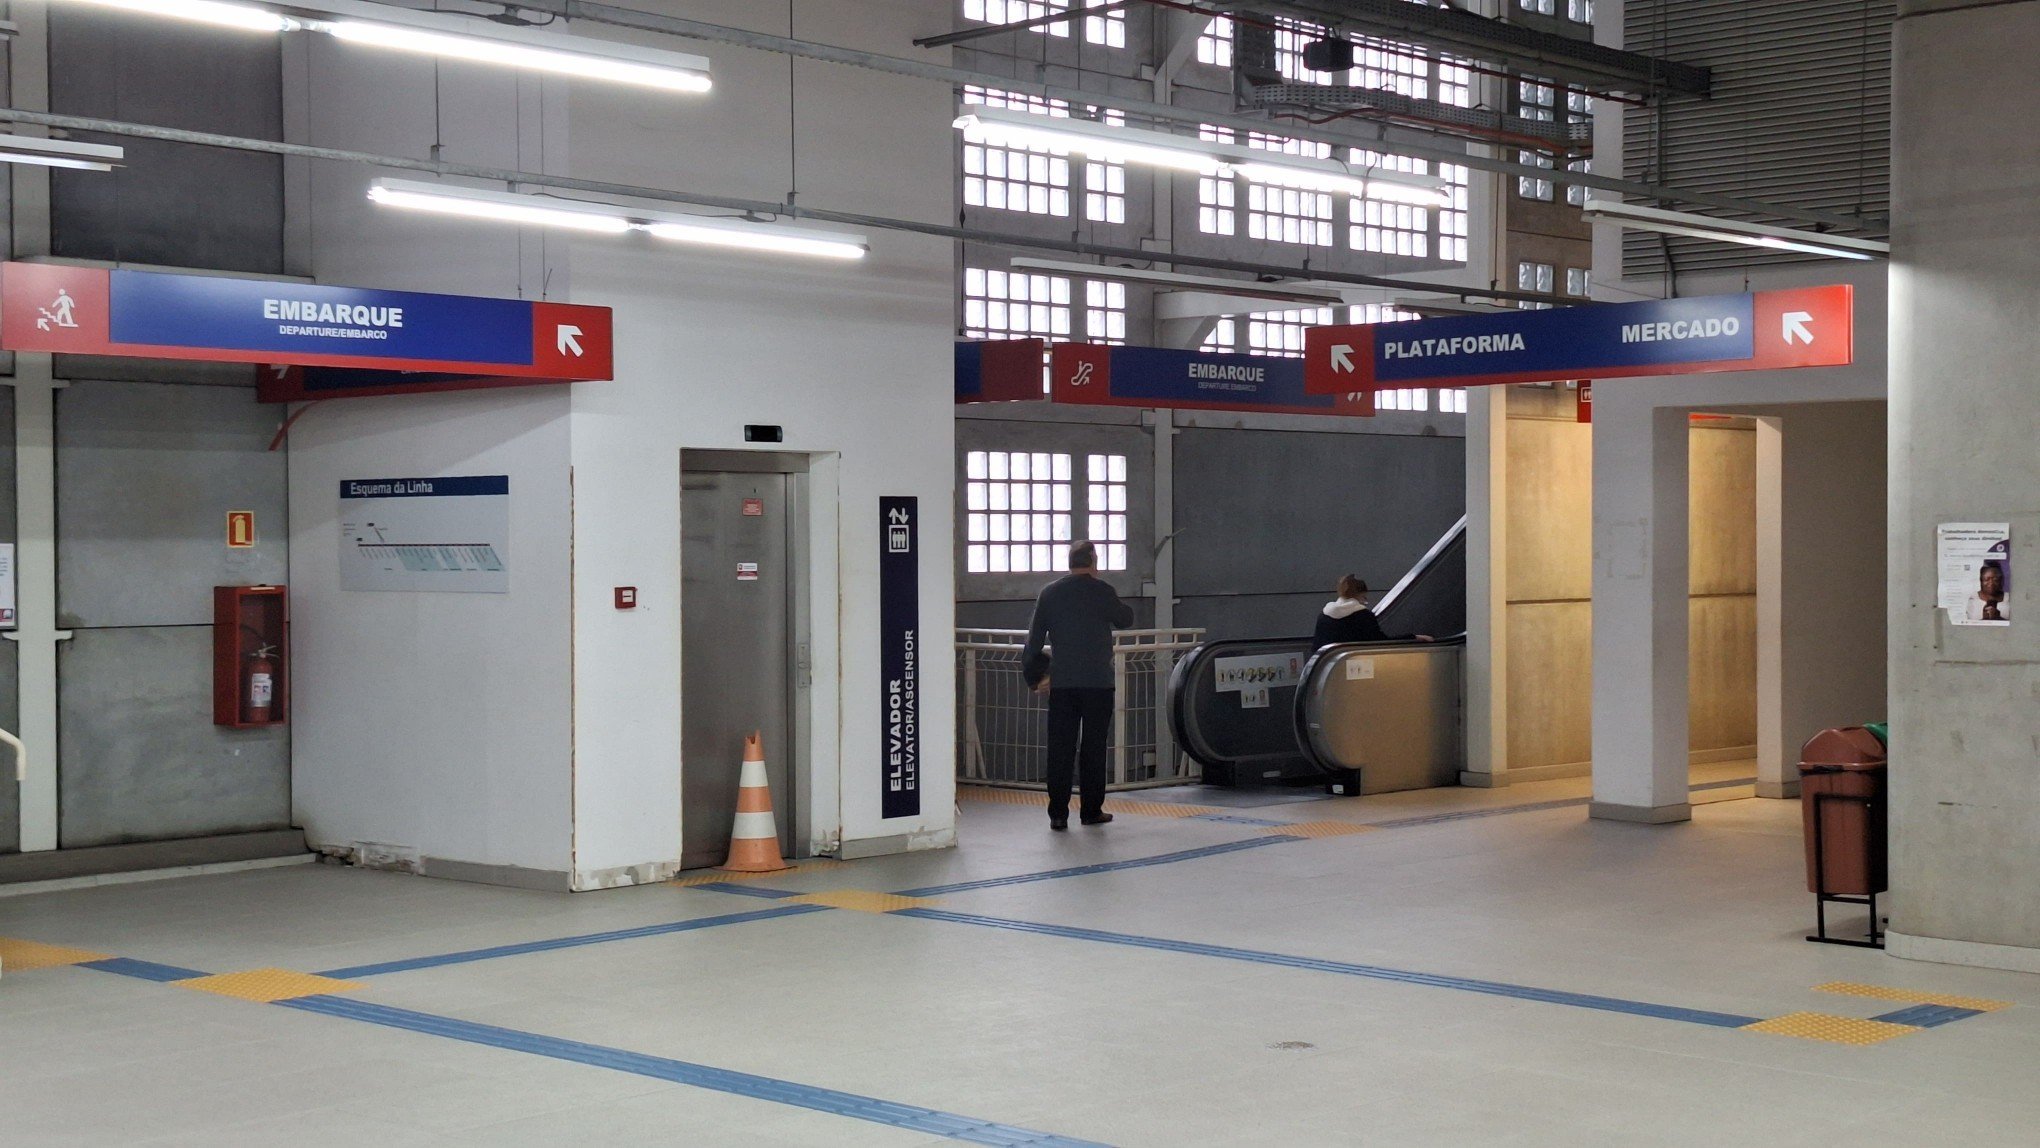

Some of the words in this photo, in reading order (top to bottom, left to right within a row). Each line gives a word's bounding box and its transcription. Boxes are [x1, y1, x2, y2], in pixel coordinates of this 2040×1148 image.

[263, 299, 403, 328] EMBARQUE
[279, 324, 388, 340] DEPARTURE/EMBARCO
[1621, 316, 1740, 343] MERCADO
[1384, 333, 1526, 360] PLATAFORMA
[1188, 363, 1264, 382] EMBARQUE
[350, 482, 392, 497] Esquema
[394, 481, 405, 494] da
[407, 480, 433, 494] Linha
[904, 629, 915, 790] ELEVATOR/ASCENSOR
[889, 678, 902, 791] ELEVADOR
